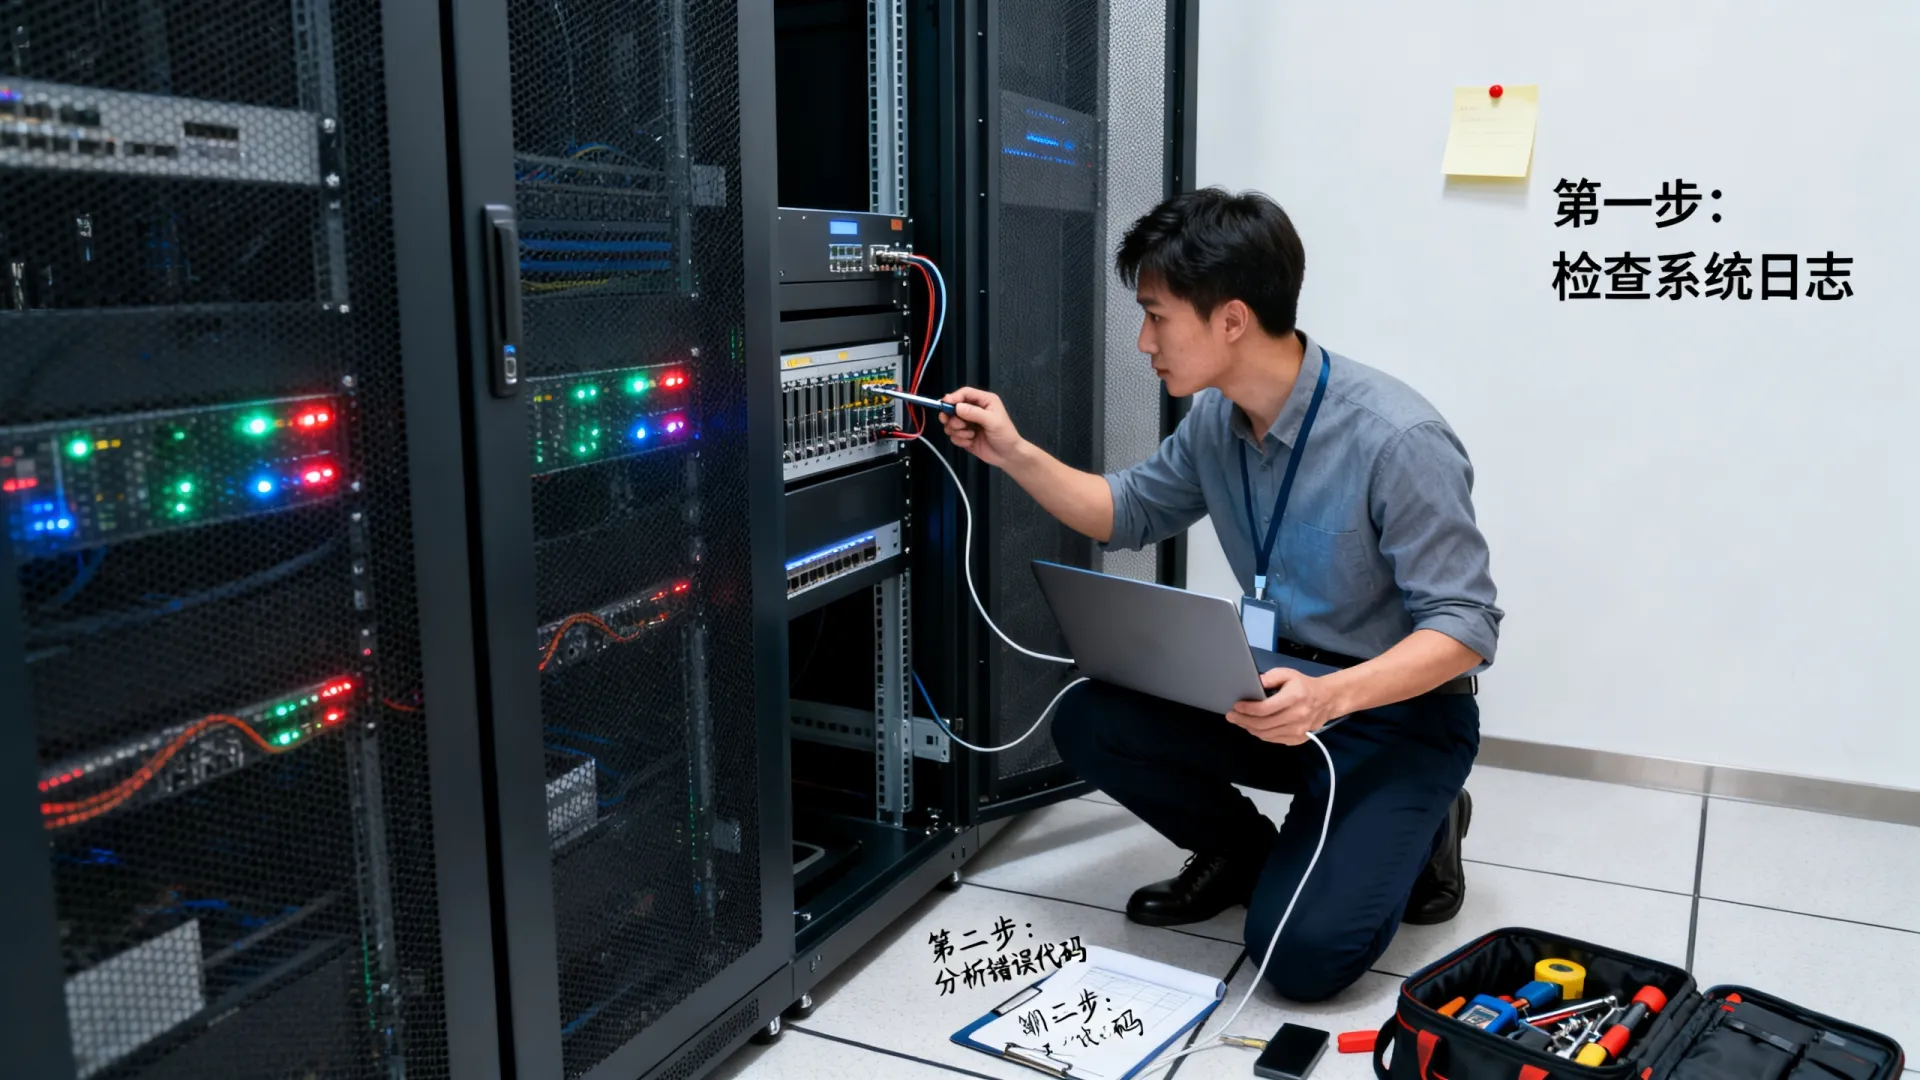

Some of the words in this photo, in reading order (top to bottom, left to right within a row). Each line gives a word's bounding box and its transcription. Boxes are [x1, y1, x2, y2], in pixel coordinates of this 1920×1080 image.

[928, 916, 1033, 964] 第二步：
[935, 936, 1087, 996] 分析错误代码
